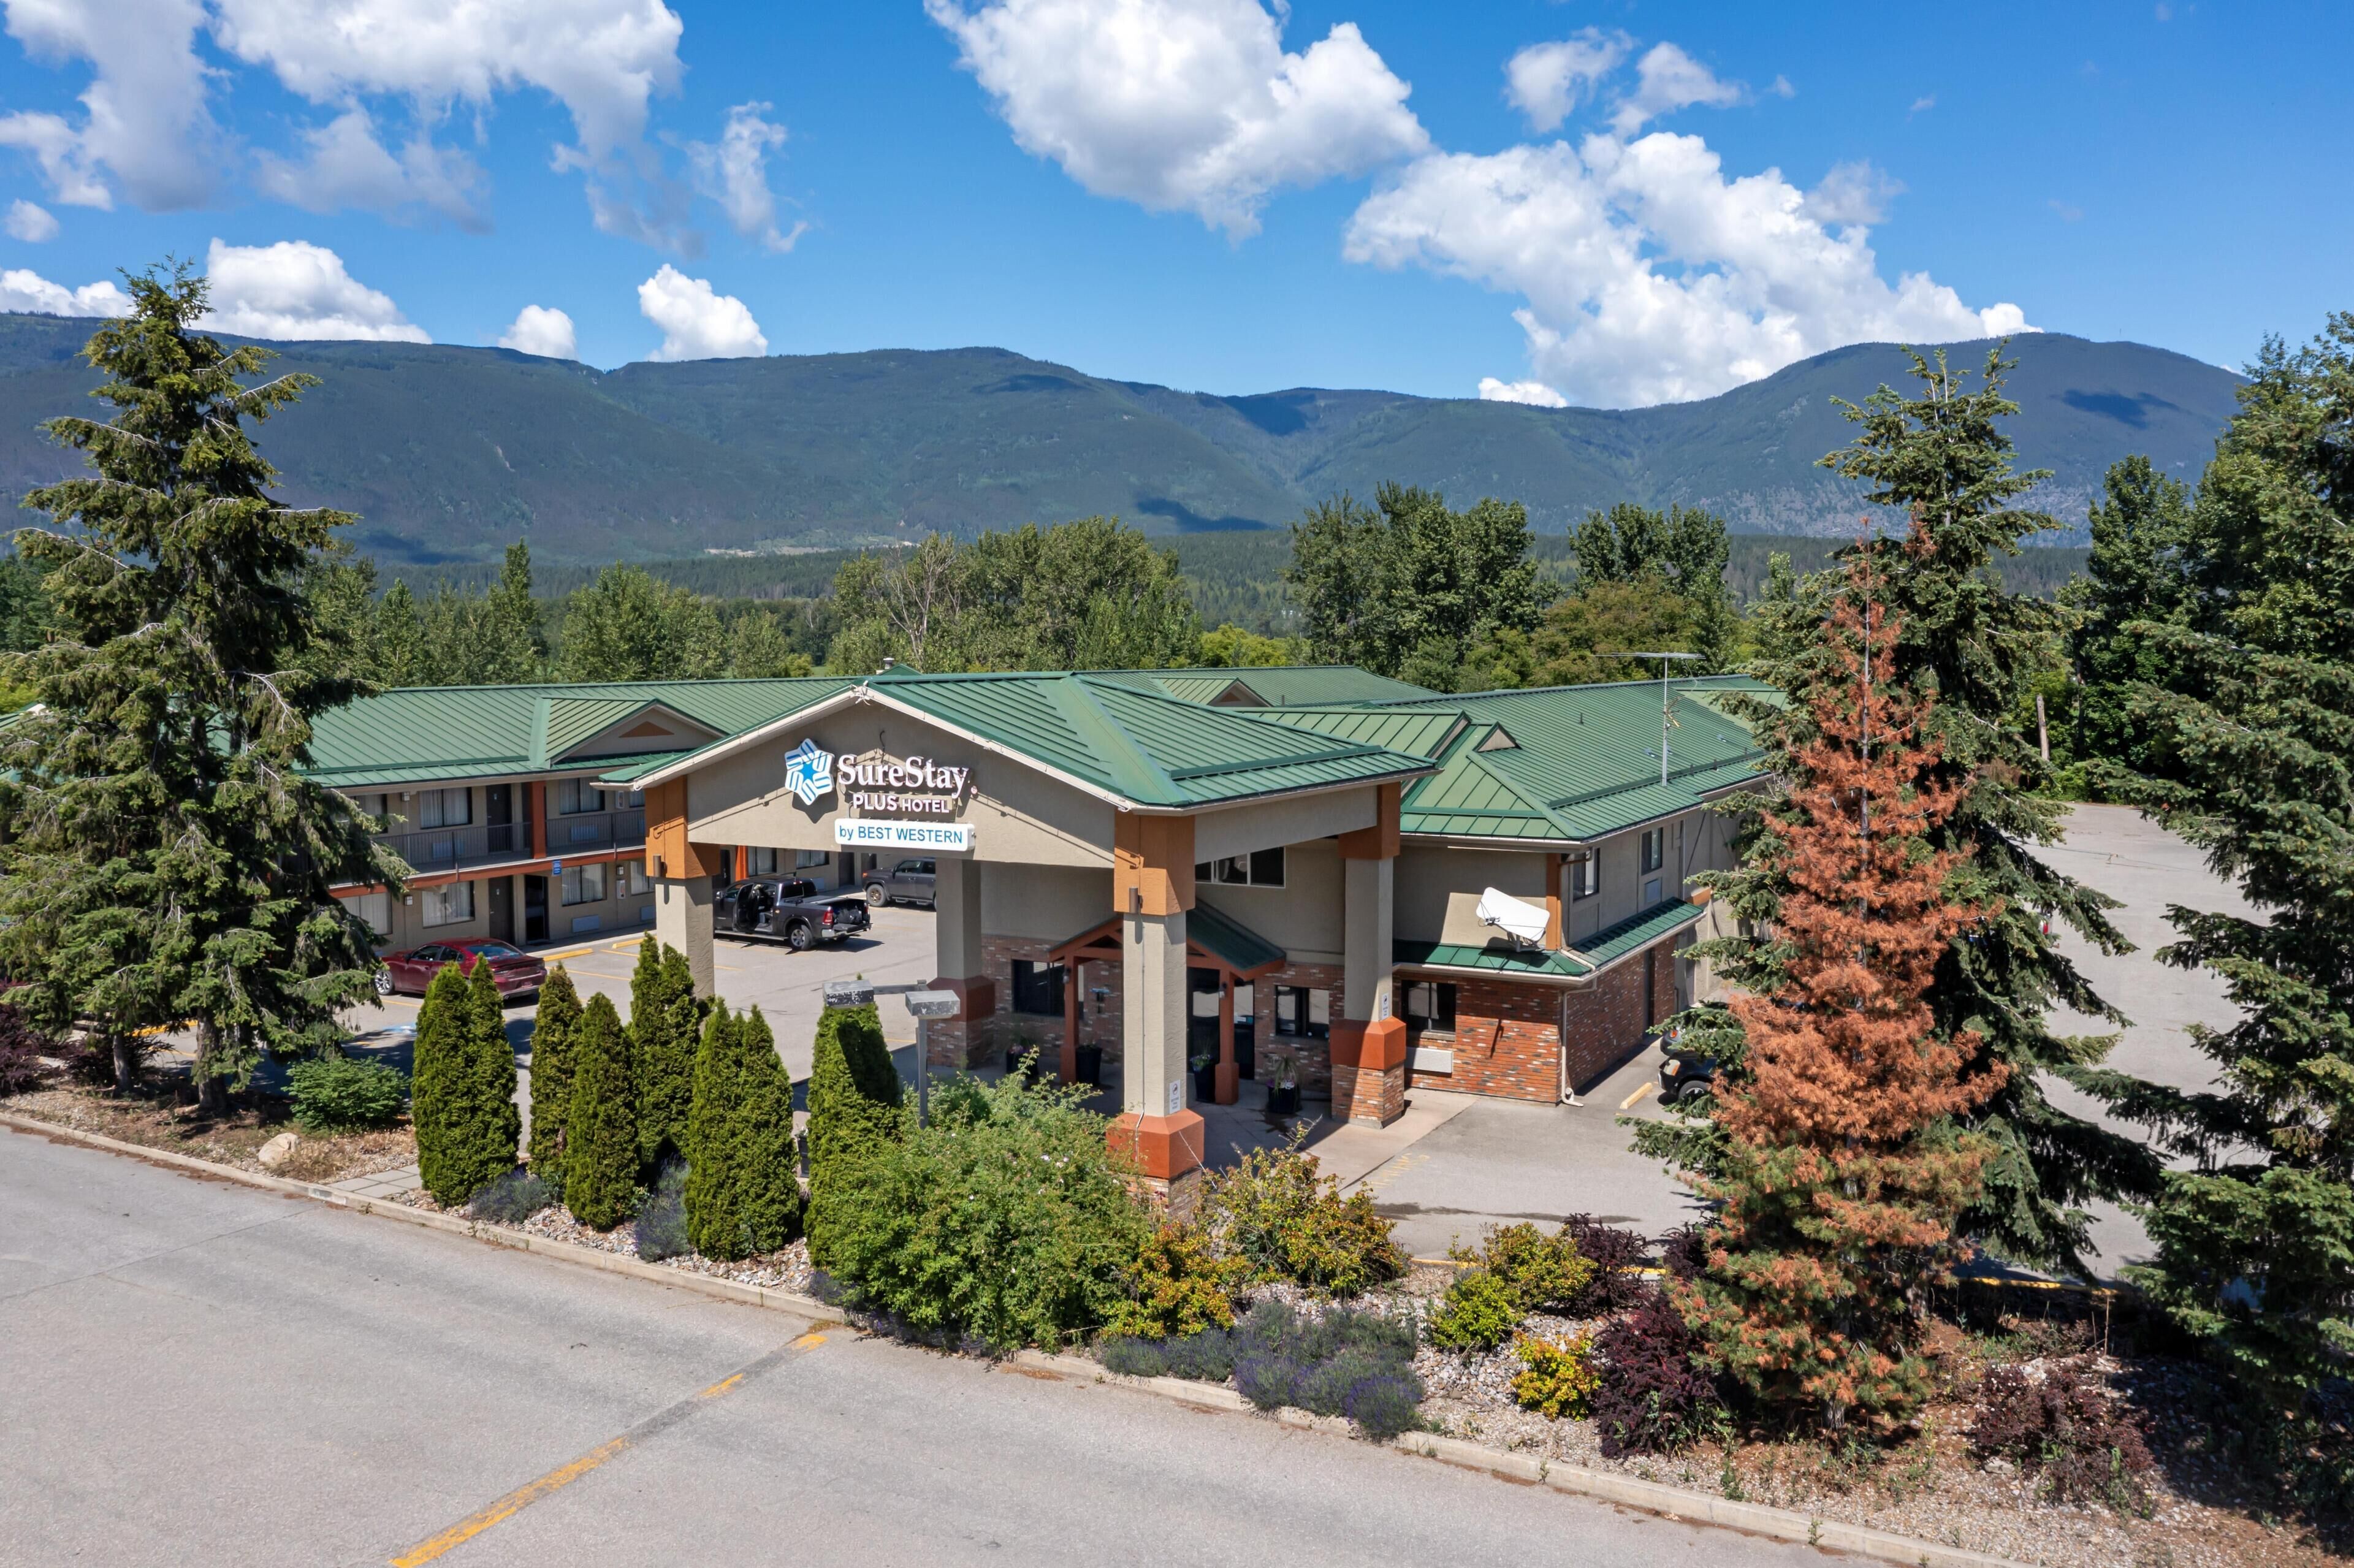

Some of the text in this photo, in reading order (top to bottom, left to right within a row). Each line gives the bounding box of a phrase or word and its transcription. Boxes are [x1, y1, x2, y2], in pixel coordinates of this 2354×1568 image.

[838, 754, 969, 799] SureStay
[853, 794, 950, 813] PLUS HOTEL
[839, 825, 962, 843] by BEST WESTERN
